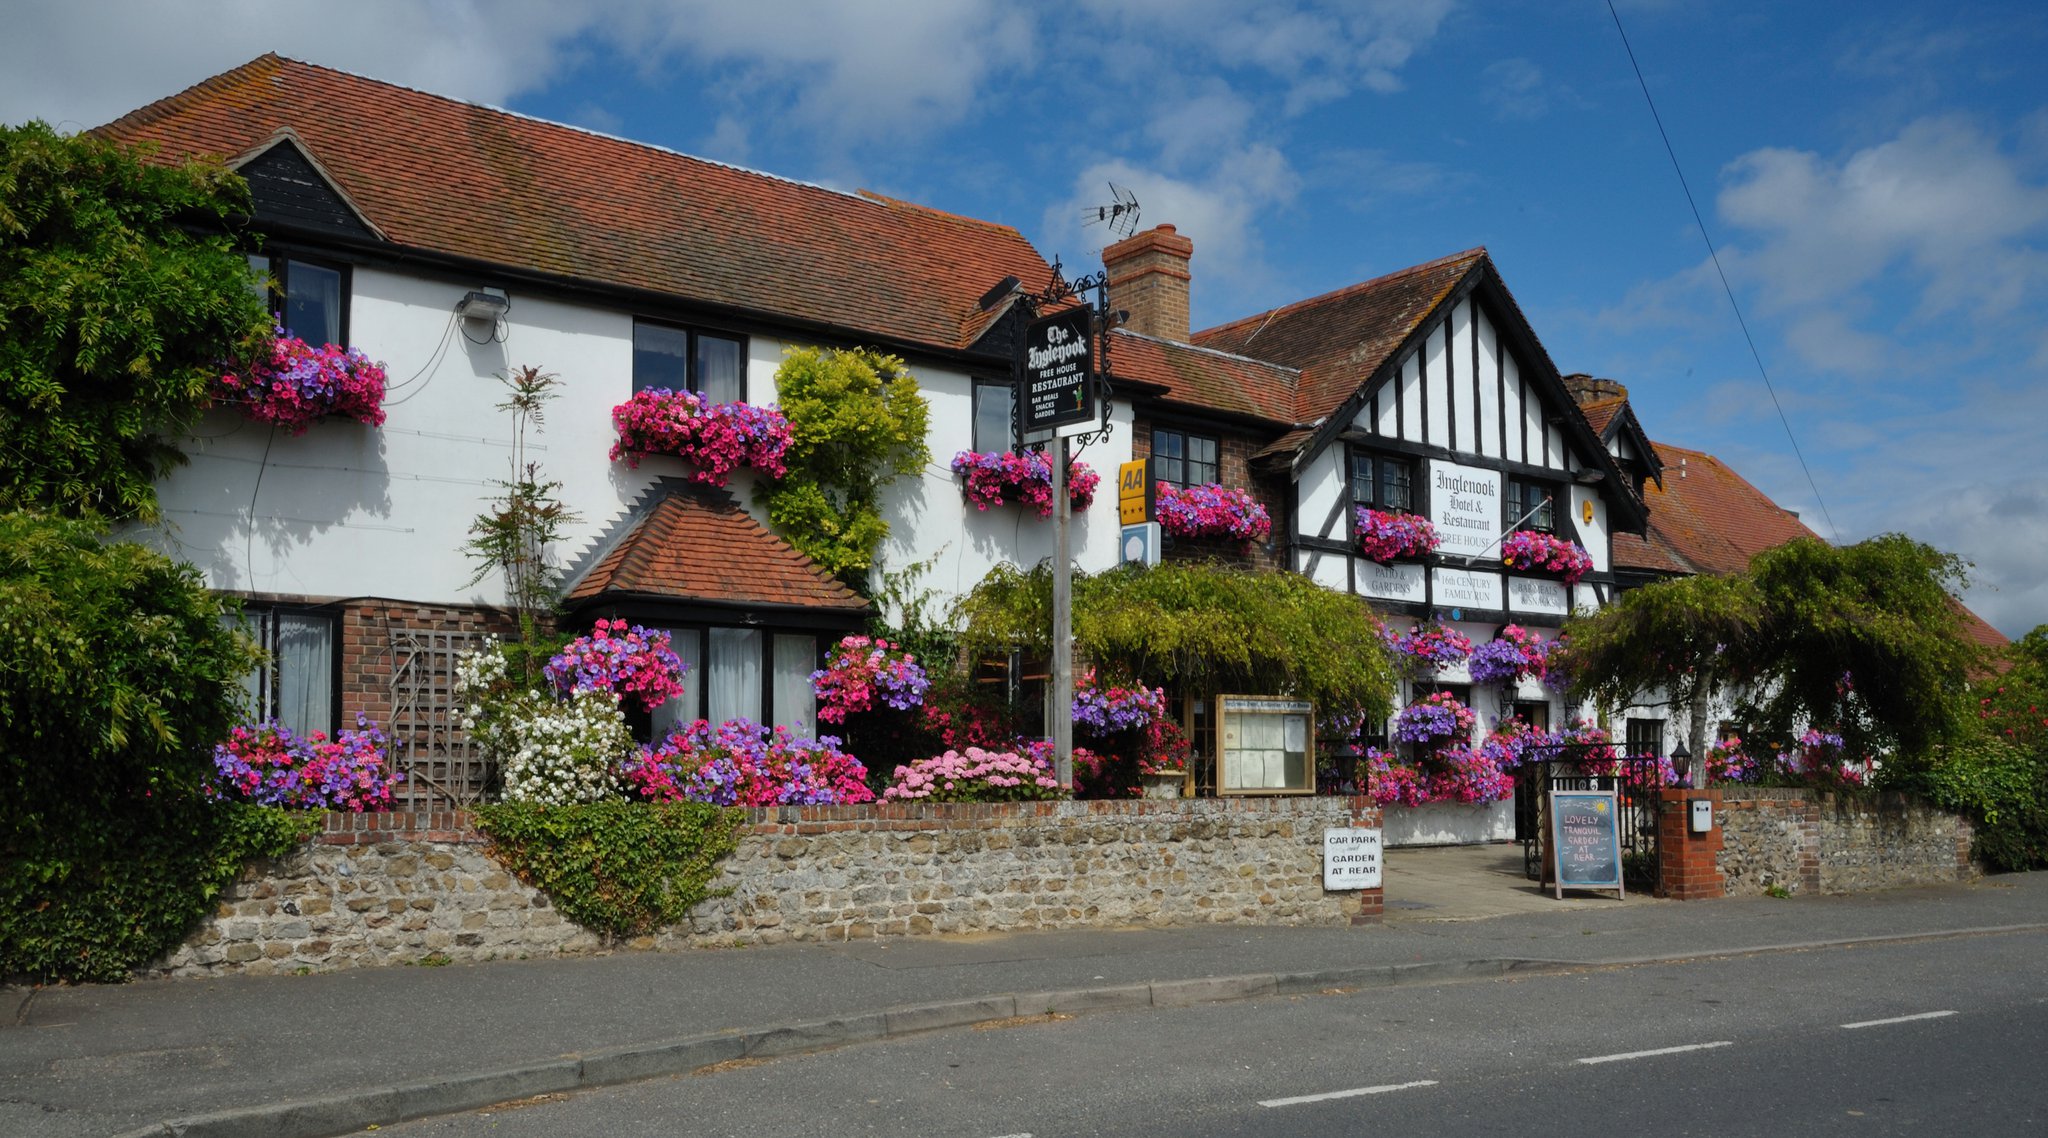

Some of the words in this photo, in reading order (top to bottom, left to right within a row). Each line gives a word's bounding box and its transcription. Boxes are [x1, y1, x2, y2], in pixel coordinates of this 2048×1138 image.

[1047, 325, 1068, 344] The
[1028, 336, 1086, 370] Inglenook
[1039, 368, 1054, 379] FREE
[1056, 362, 1077, 375] HOUSE
[1032, 372, 1084, 393] RESTAURANT
[1032, 396, 1041, 404] BAR
[1043, 392, 1058, 402] MEALS
[1035, 401, 1055, 412] SNACKS
[1034, 409, 1055, 419] GARDEN
[1122, 468, 1143, 492] AA
[1436, 470, 1495, 497] Inglenook
[1450, 495, 1475, 513] Hotel
[1475, 500, 1483, 514] &
[1442, 511, 1490, 532] Restaurant
[1442, 532, 1462, 545] FREE
[1464, 535, 1491, 548] HOUSE
[1375, 567, 1398, 580] PATIO
[1371, 580, 1410, 593] GARDENS
[1442, 575, 1456, 586] 16th
[1456, 576, 1491, 589] CENTURY
[1444, 588, 1473, 600] FAMILY
[1474, 591, 1490, 602] RUN
[1564, 815, 1599, 825] LOVELY
[1563, 826, 1602, 835] TRANQUIL
[1329, 836, 1348, 844] CAR
[1568, 836, 1600, 845] GARDEN
[1578, 845, 1588, 853] AT
[1332, 854, 1375, 863] GARDEN
[1573, 853, 1596, 862] REAR
[1331, 867, 1344, 875] AT
[1348, 866, 1376, 875] REAR
